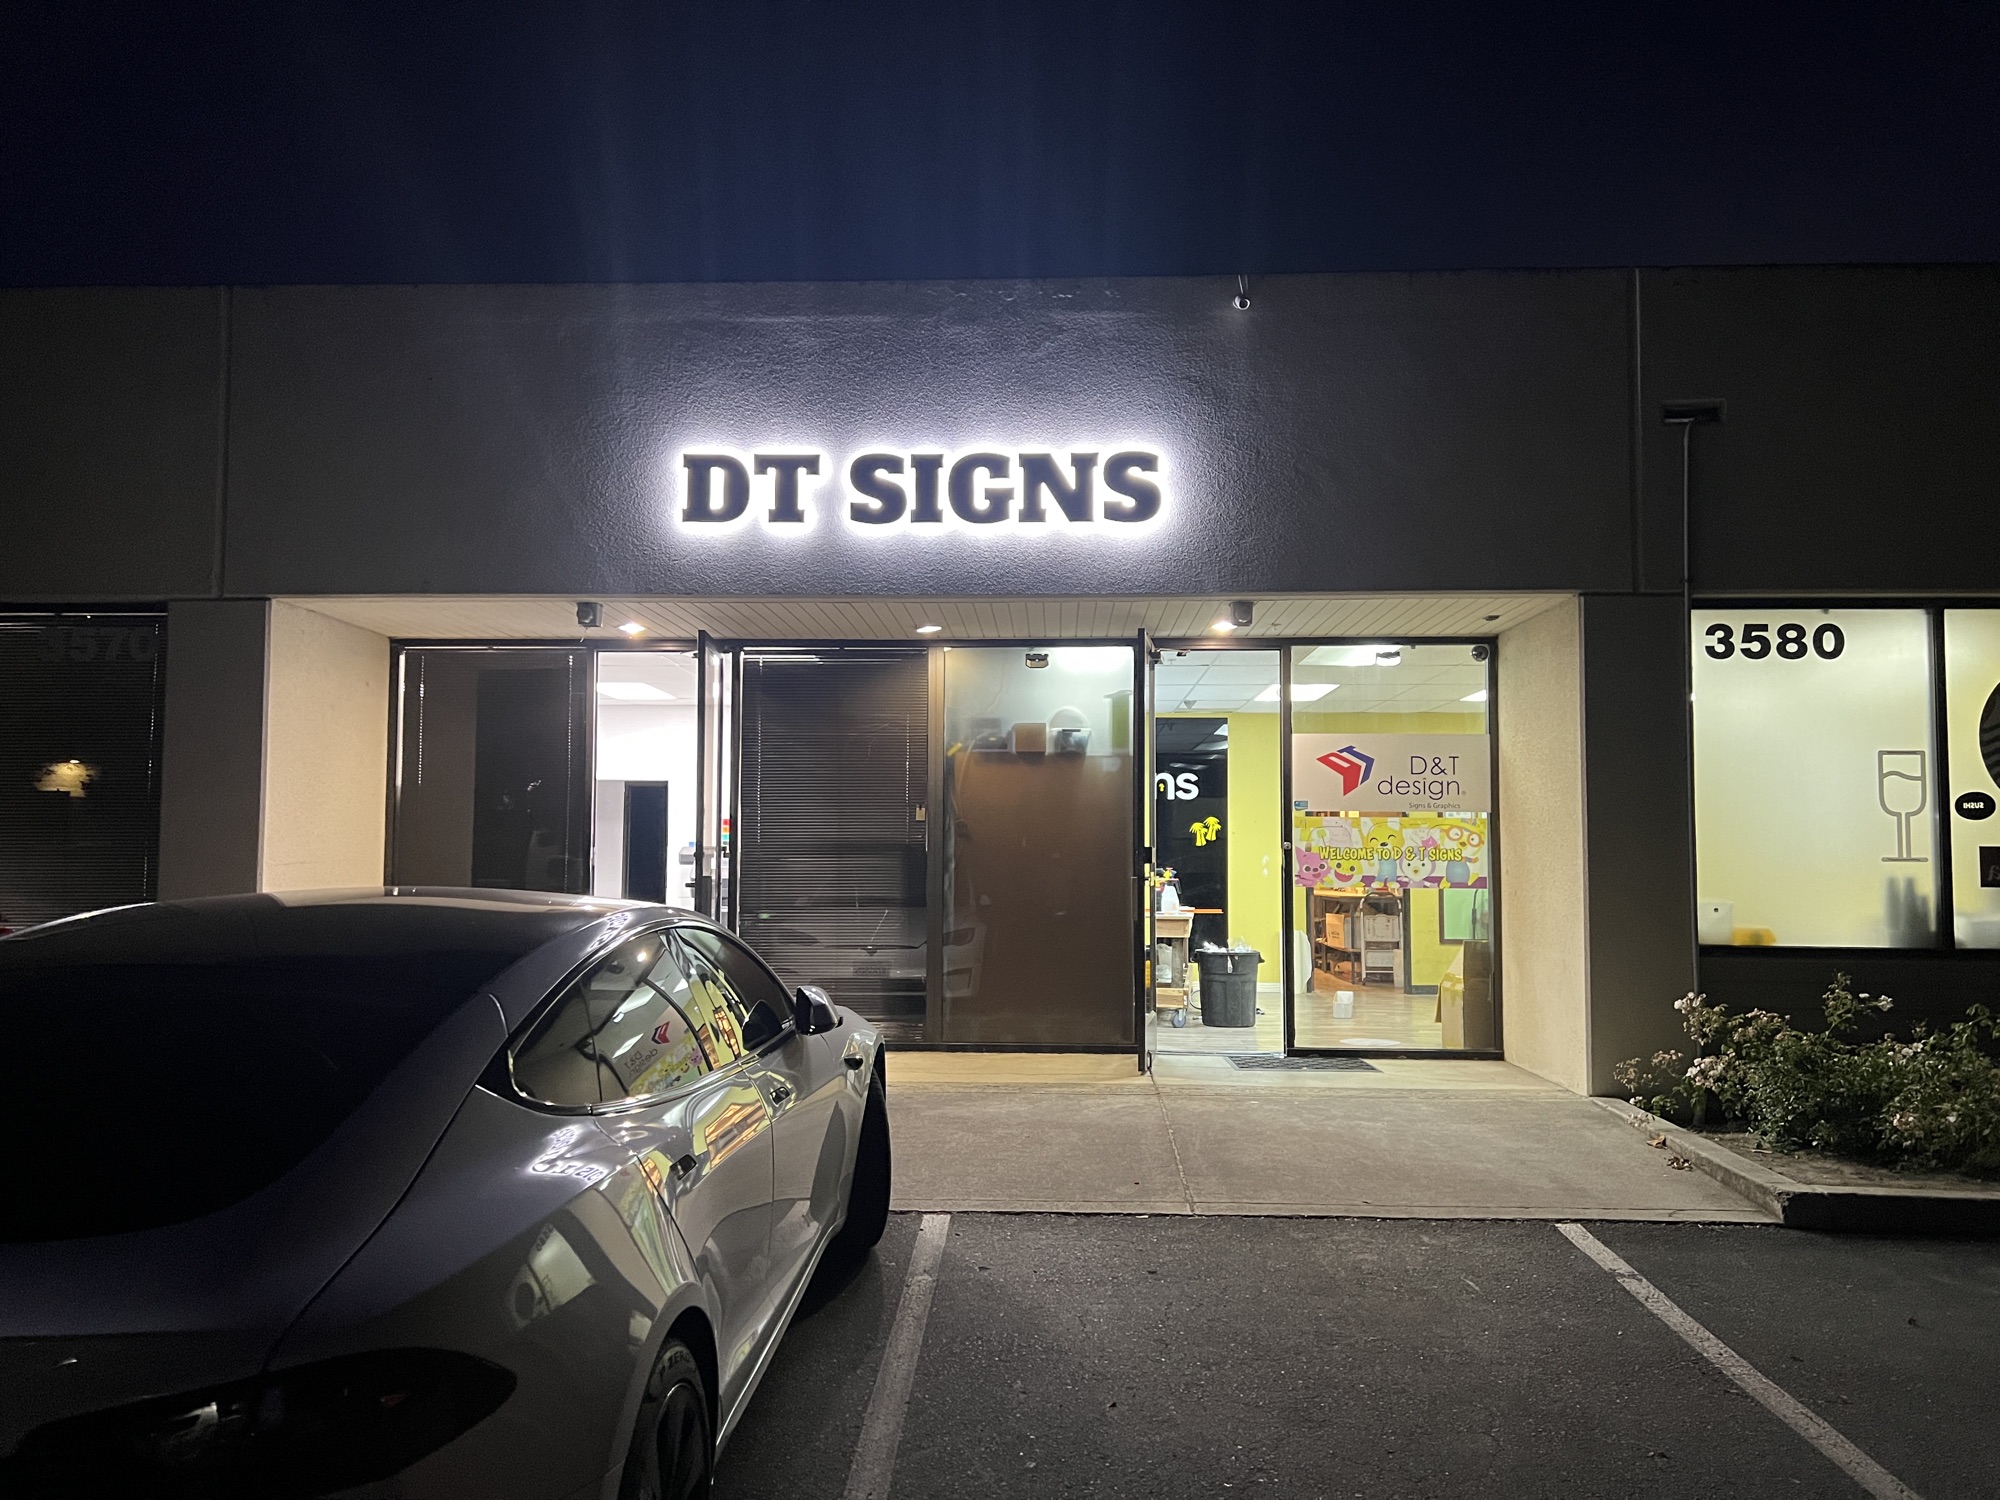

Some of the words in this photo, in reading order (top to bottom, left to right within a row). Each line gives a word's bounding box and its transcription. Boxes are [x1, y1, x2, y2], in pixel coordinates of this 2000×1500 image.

[681, 453, 821, 523] DT
[849, 452, 1162, 524] SIGNS
[1704, 622, 1846, 660] 3580
[1410, 755, 1460, 776] D&T
[1319, 846, 1374, 860] WELCOME
[1376, 847, 1390, 859] TO
[1394, 847, 1403, 860] D
[1405, 847, 1415, 859] &
[1419, 847, 1427, 860] T
[1428, 848, 1463, 861] SIGNS
